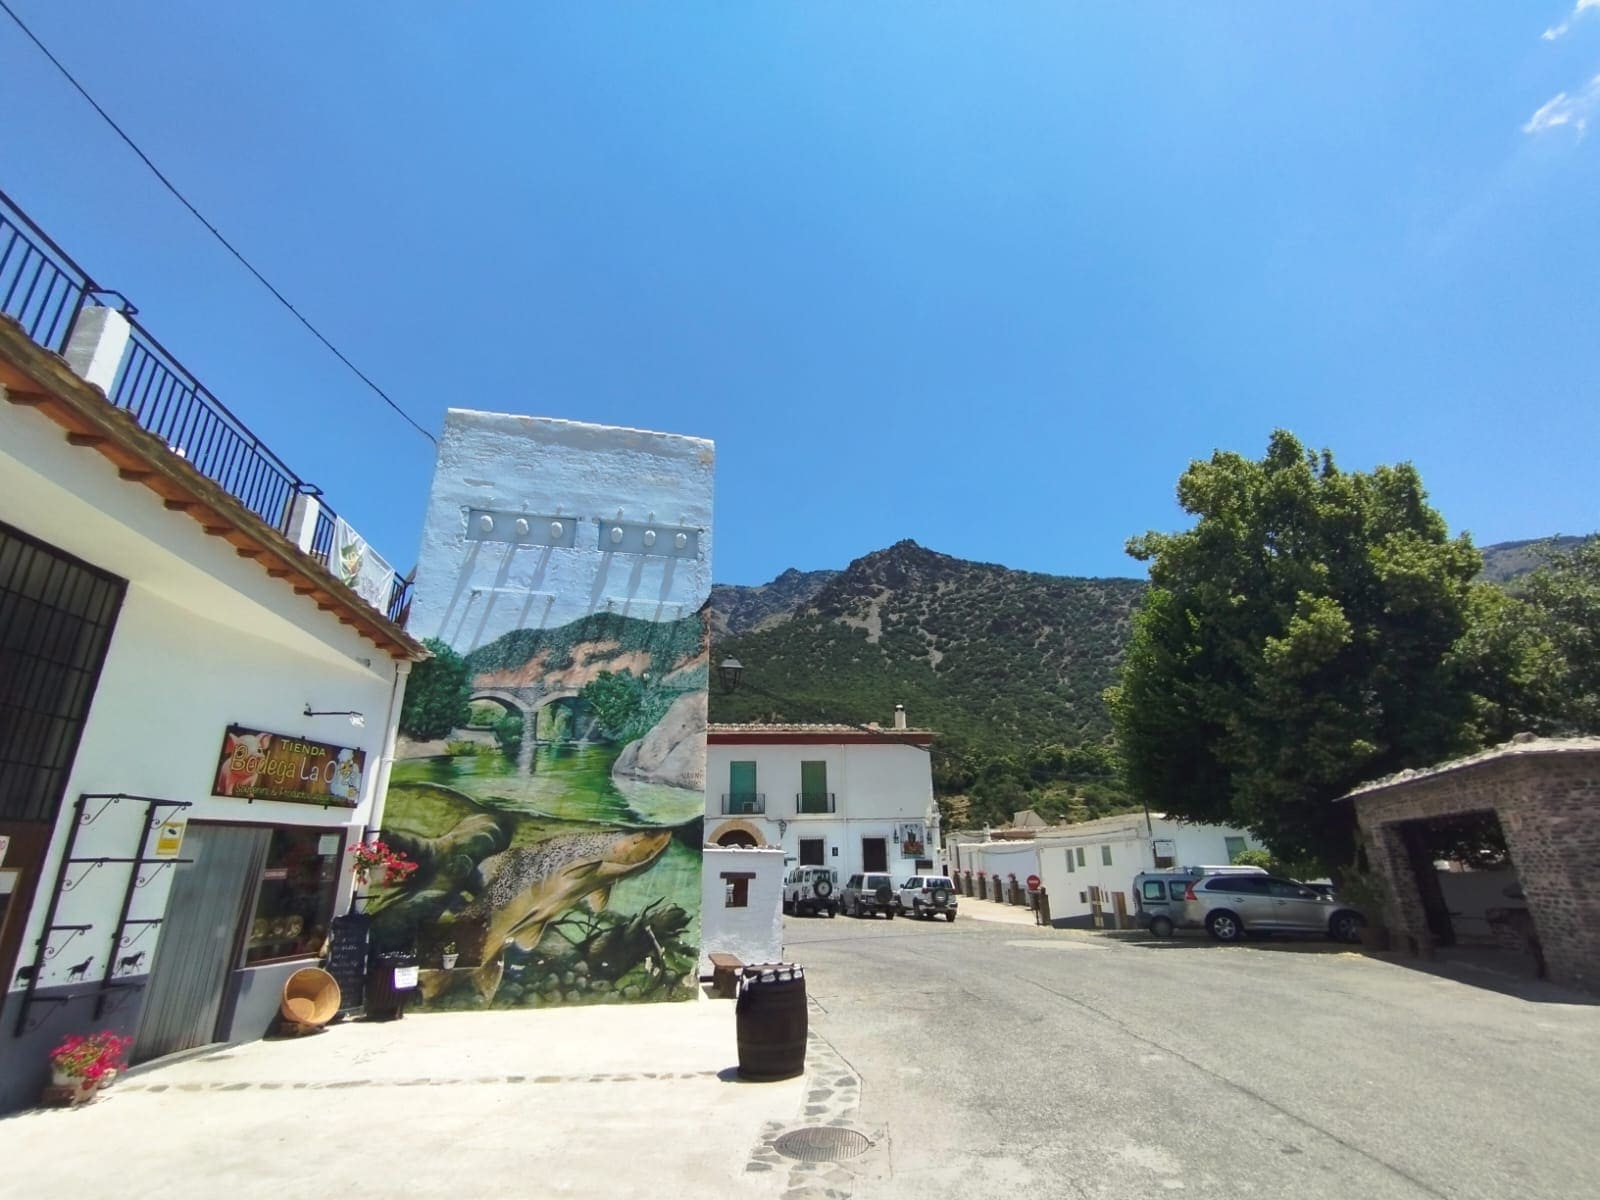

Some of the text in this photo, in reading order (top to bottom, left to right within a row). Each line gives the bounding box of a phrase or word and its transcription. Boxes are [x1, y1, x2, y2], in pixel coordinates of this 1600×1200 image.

[281, 739, 325, 757] TIENDA
[231, 745, 337, 783] Bodega La O
